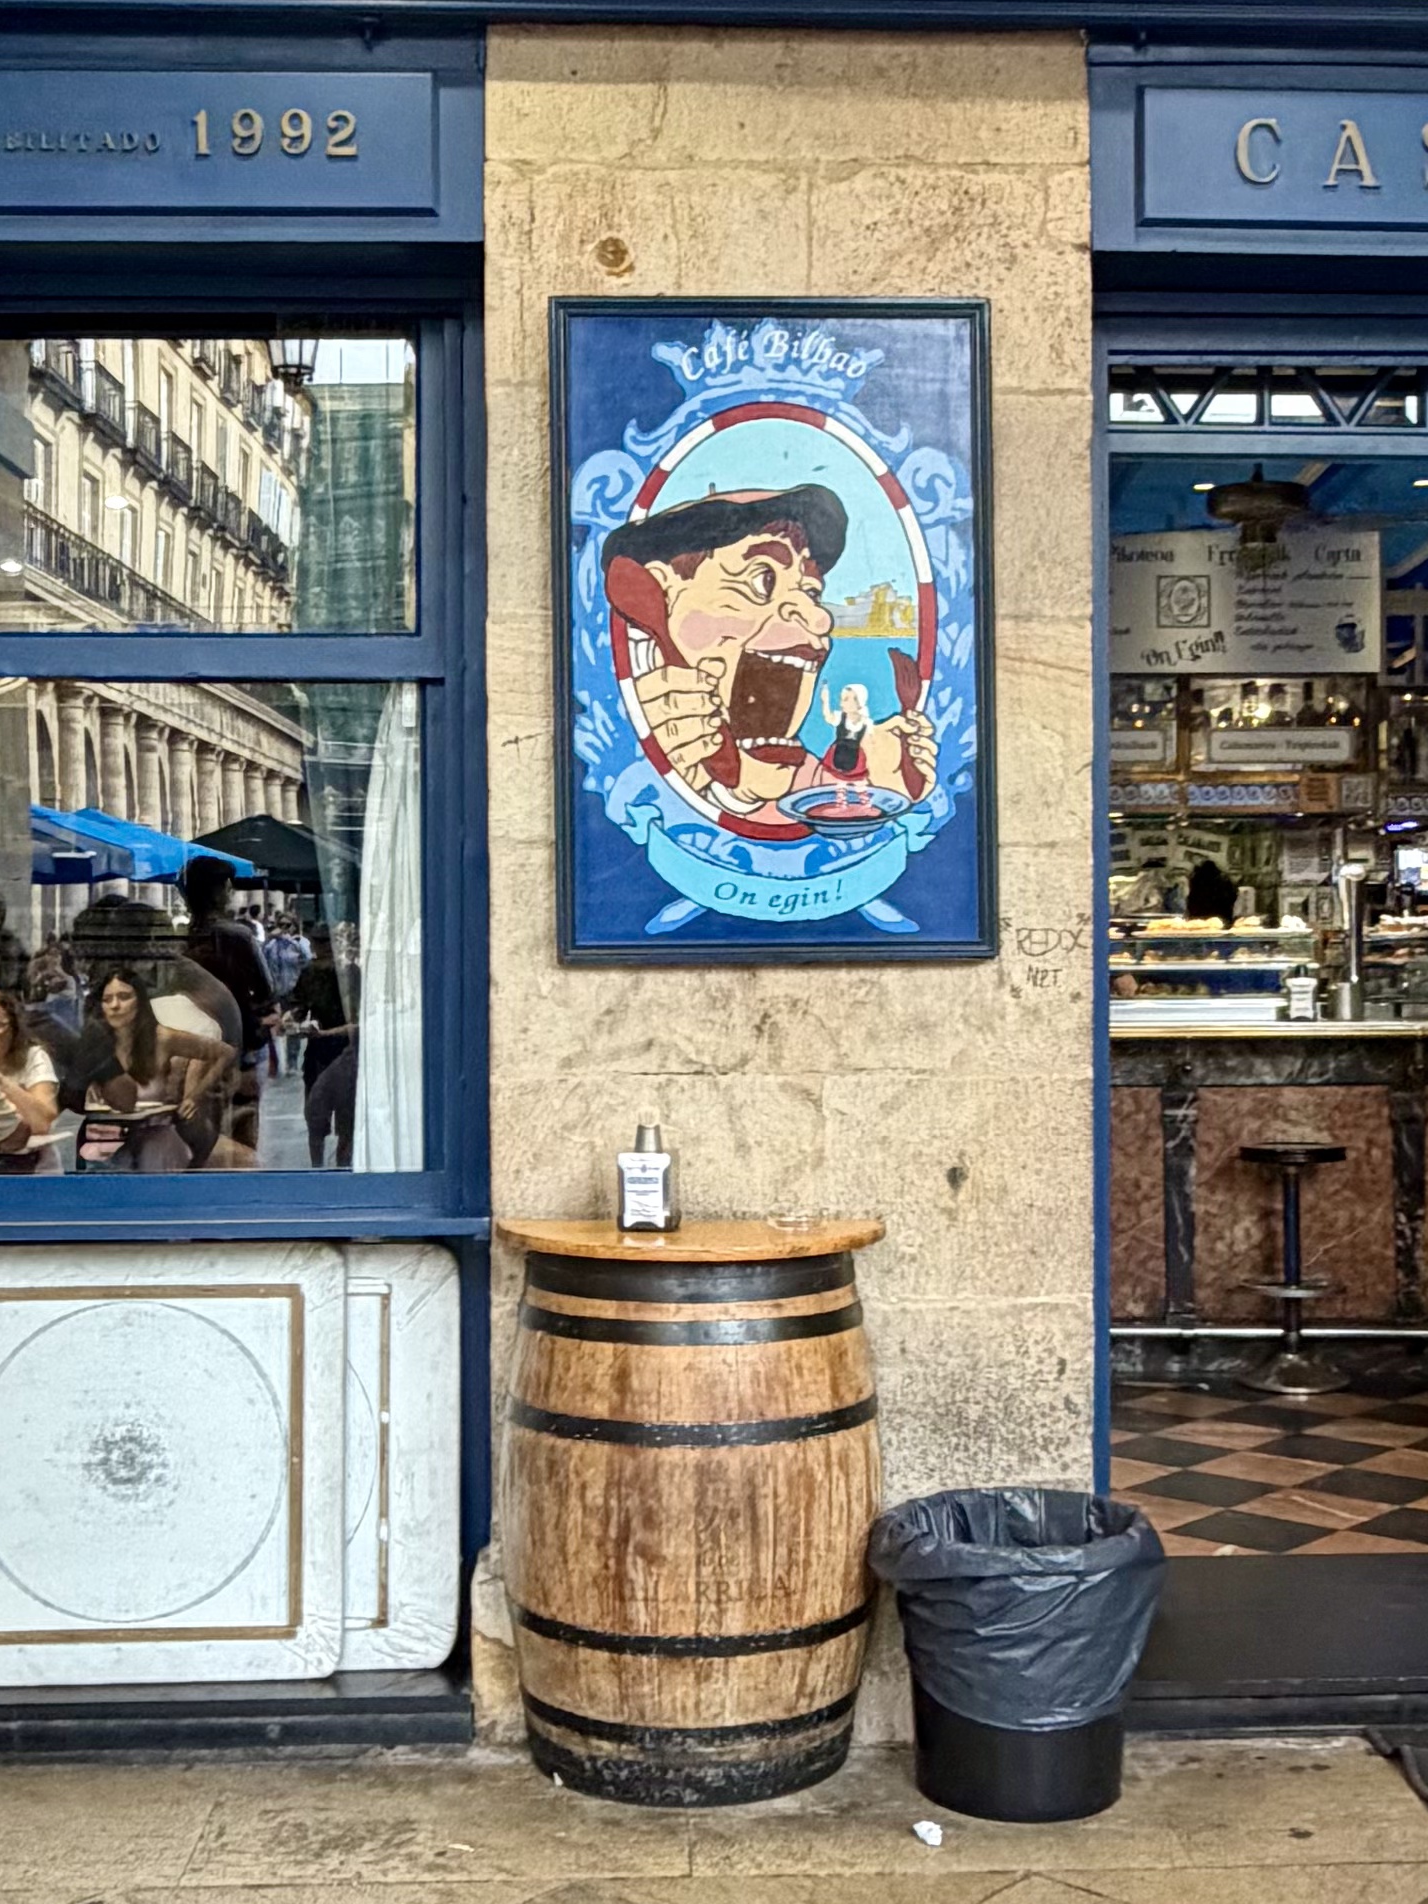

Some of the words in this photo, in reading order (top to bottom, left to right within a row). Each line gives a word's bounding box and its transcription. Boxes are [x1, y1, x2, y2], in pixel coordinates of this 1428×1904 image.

[191, 108, 359, 156] 1992
[680, 329, 751, 382] Café
[762, 328, 868, 379] Bilbao
[713, 881, 759, 906] On
[767, 878, 843, 916] egin!
